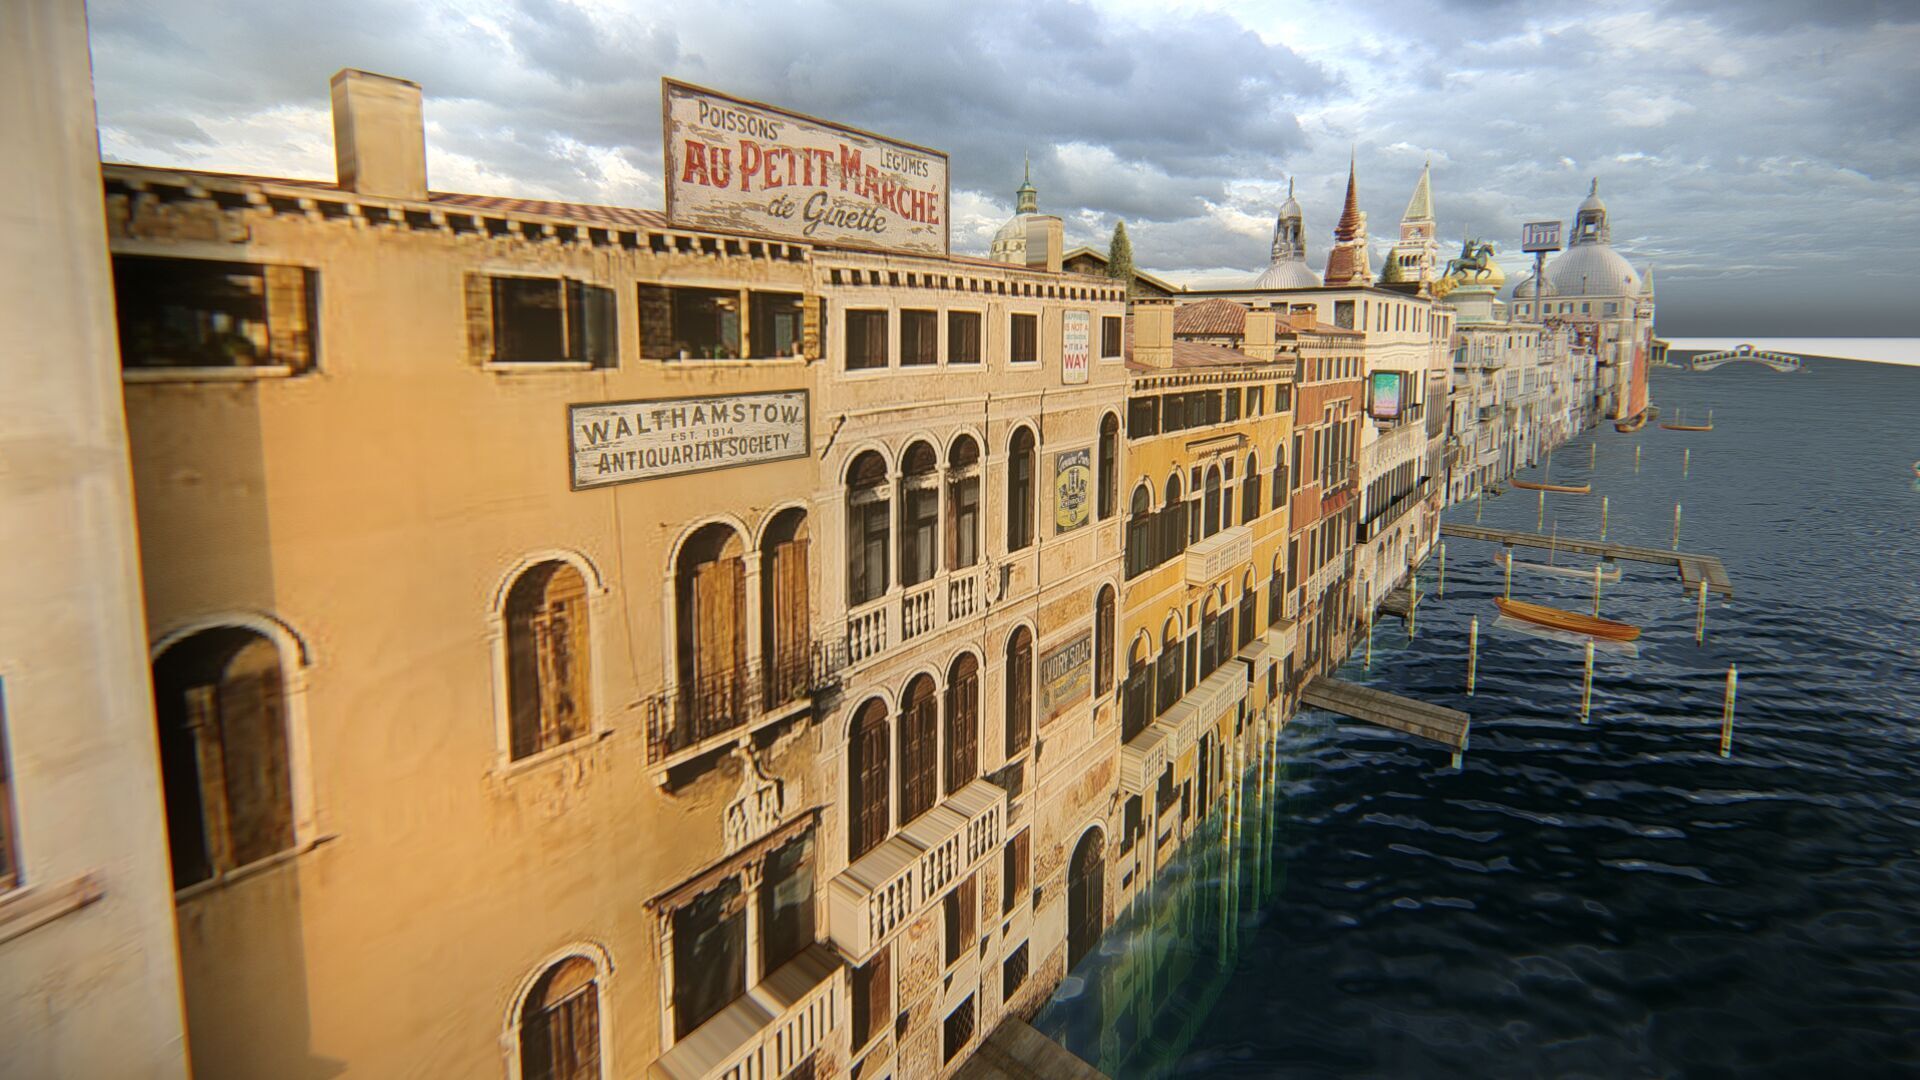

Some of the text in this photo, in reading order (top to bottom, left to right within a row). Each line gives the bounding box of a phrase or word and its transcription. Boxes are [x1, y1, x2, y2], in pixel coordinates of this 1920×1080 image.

[699, 100, 779, 141] POISSONS
[682, 139, 940, 225] AU PETIT MARCHÉ
[880, 147, 929, 178] LÉGUMES
[767, 191, 887, 237] de Ginette
[1071, 323, 1083, 332] NOT
[1064, 353, 1088, 369] WAY
[582, 403, 800, 446] WALTHAMSTOW
[671, 426, 734, 442] EST. 1914
[597, 432, 790, 475] ANTIQUARIAN SOCIETY
[1042, 651, 1070, 686] IVORY
[1069, 638, 1091, 669] SOAP
